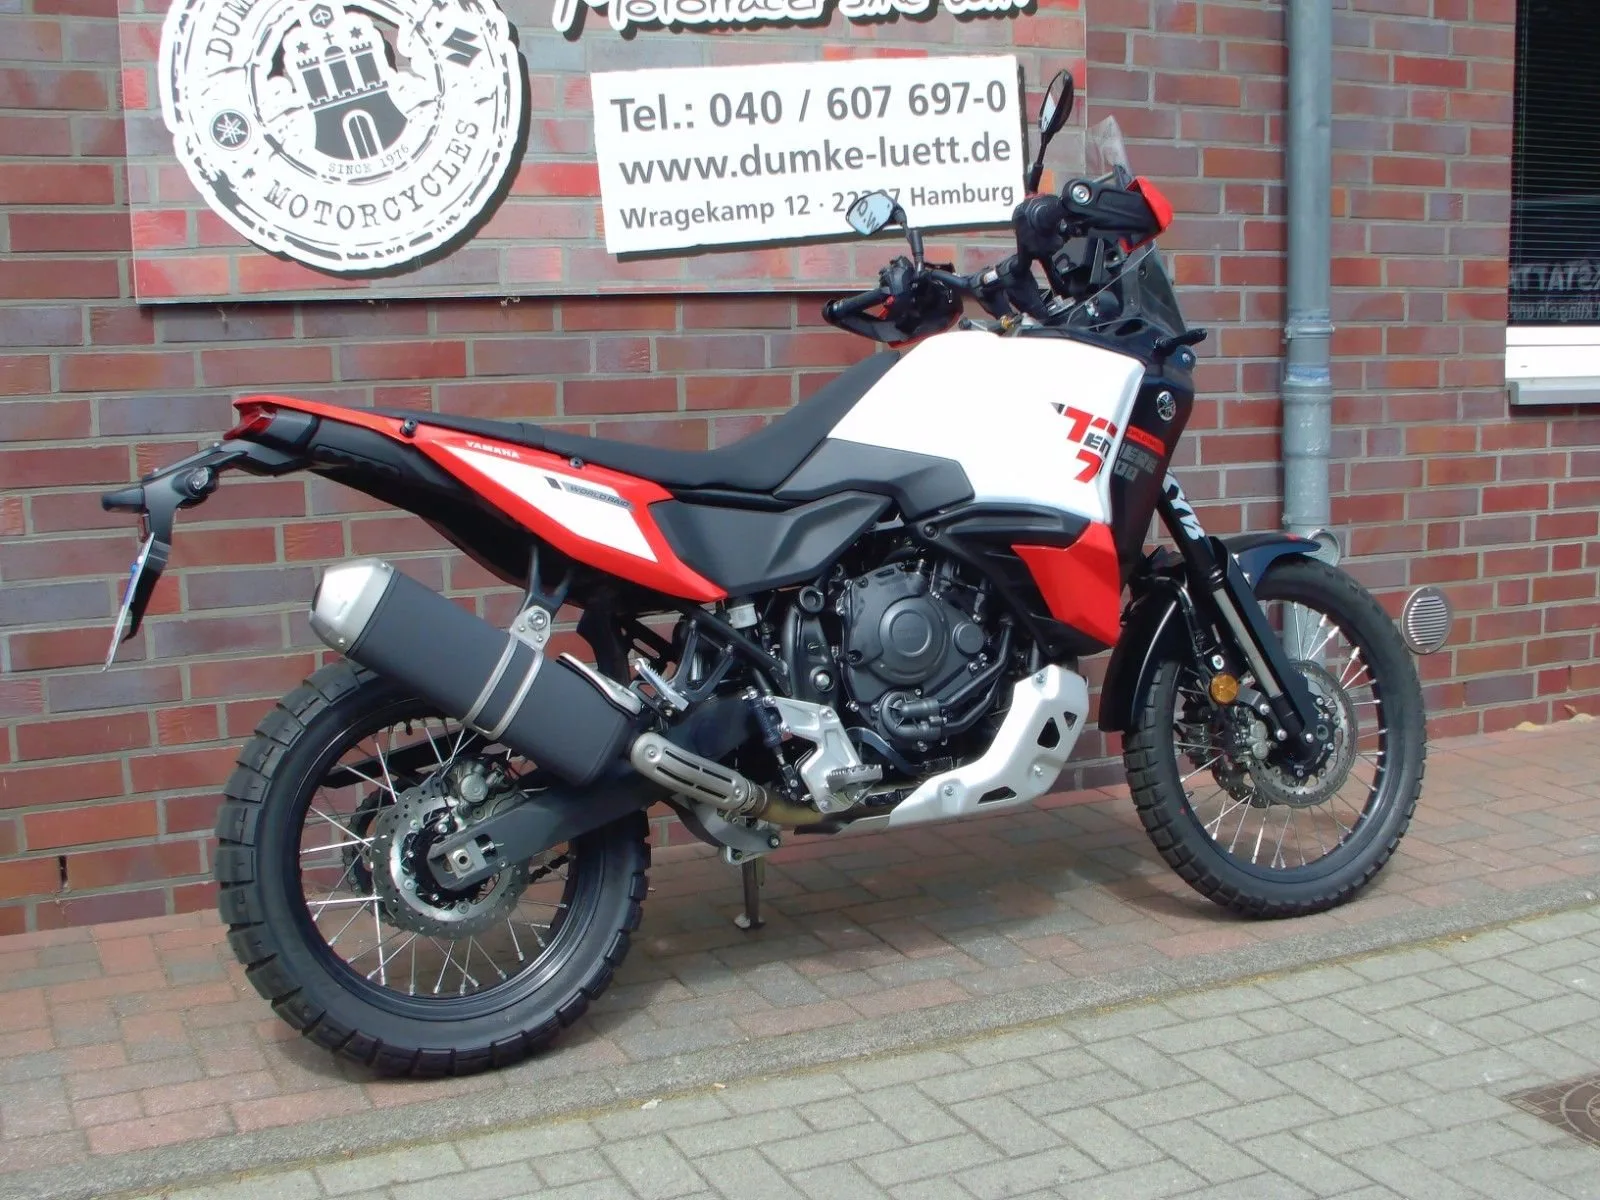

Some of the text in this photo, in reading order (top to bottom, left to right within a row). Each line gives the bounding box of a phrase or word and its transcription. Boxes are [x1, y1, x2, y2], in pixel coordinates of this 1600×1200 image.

[610, 93, 695, 133] Tel.:
[709, 90, 783, 128] 040
[826, 85, 893, 120] 607
[907, 80, 1007, 116] 697-0
[263, 119, 480, 231] MOTORCYCLES
[327, 143, 411, 175] SINCE 1976
[619, 131, 1011, 185] www.dumke-luett.de
[619, 182, 1015, 231] Wragekamp 12 227 Hamburg
[465, 439, 520, 459] YAMAHA
[569, 484, 631, 508] WORLD RAID
